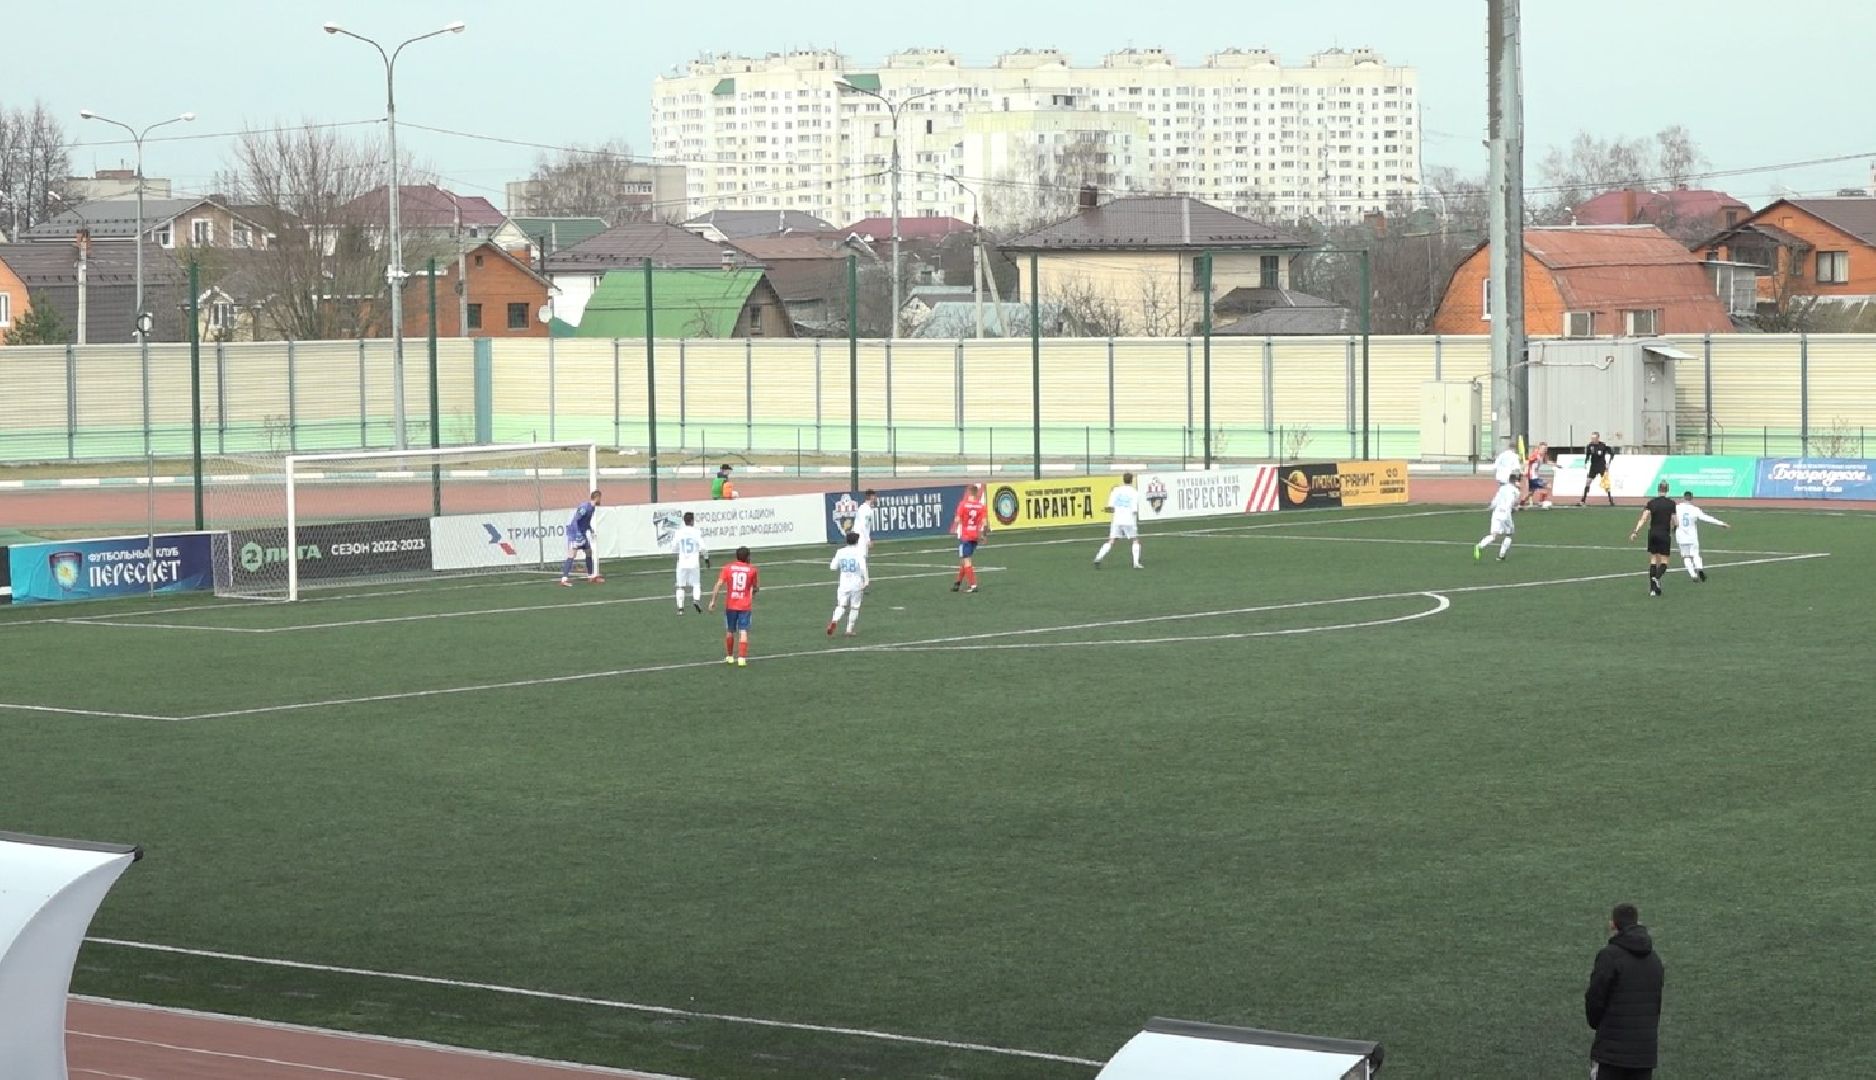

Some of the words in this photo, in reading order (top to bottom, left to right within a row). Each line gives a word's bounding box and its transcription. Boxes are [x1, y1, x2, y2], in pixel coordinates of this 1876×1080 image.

[1177, 486, 1241, 511] ПЕРЕСВЕТ
[694, 510, 738, 524] ОРОДСКОЙ
[738, 508, 775, 521] СТАДИОН
[506, 525, 568, 541] ТРИКОЛО
[155, 546, 179, 558] КЛУБ
[331, 542, 370, 556] СЕЗОН
[680, 537, 696, 554] 15
[840, 558, 857, 573] 88
[731, 571, 748, 591] 19
